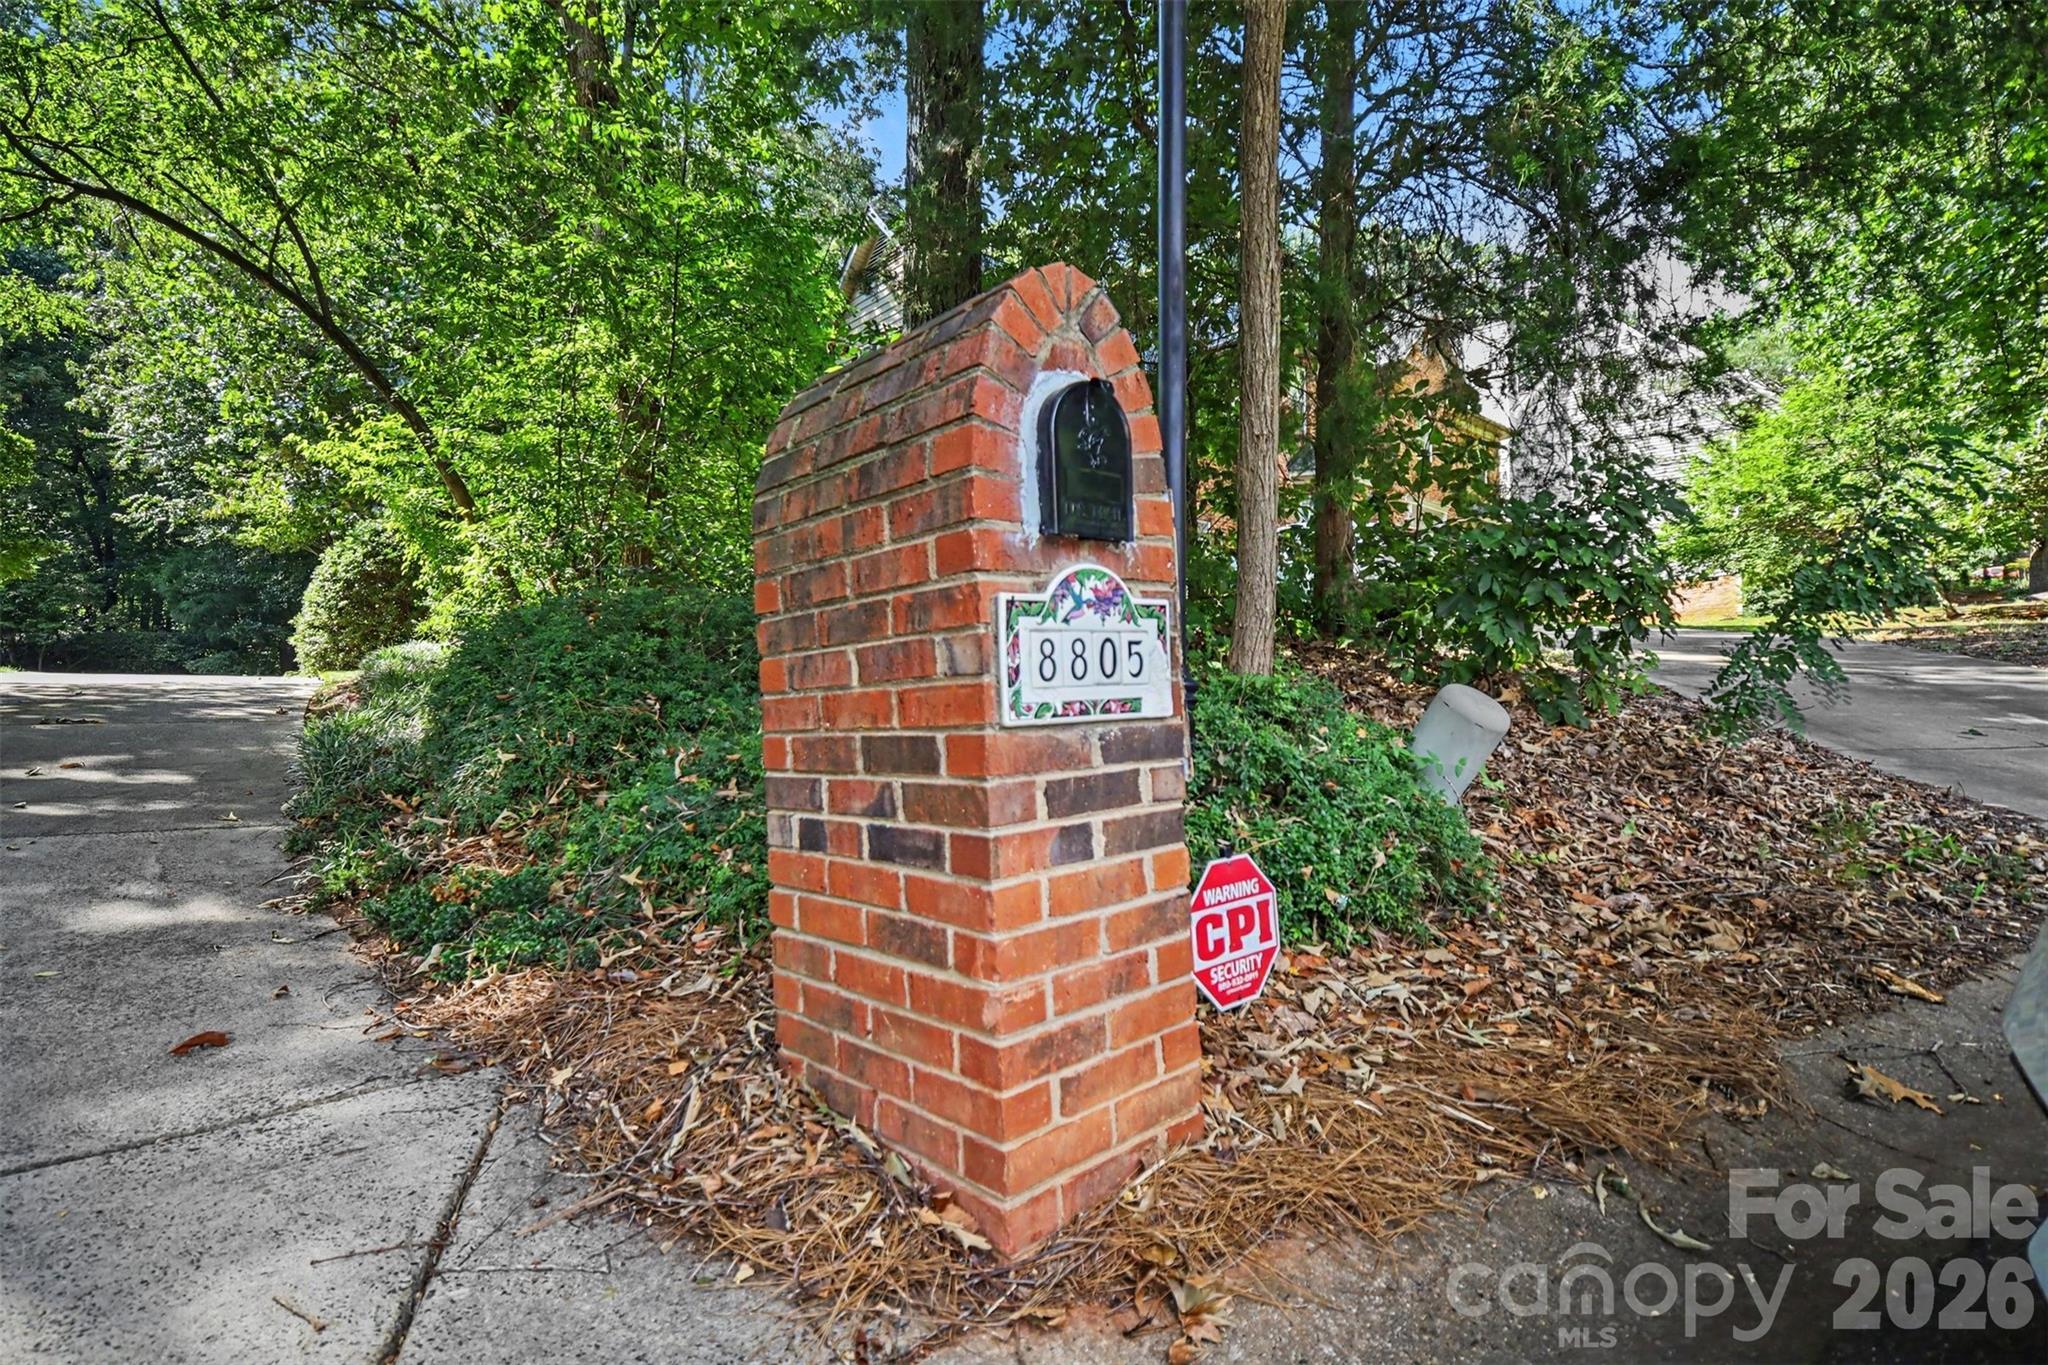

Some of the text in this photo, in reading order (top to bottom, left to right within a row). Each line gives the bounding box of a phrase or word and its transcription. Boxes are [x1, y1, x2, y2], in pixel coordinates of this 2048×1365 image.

[1039, 637, 1143, 682] 8805
[1203, 877, 1260, 907] WARNING
[1195, 899, 1273, 962] CPI
[1209, 952, 1264, 986] SECURITY
